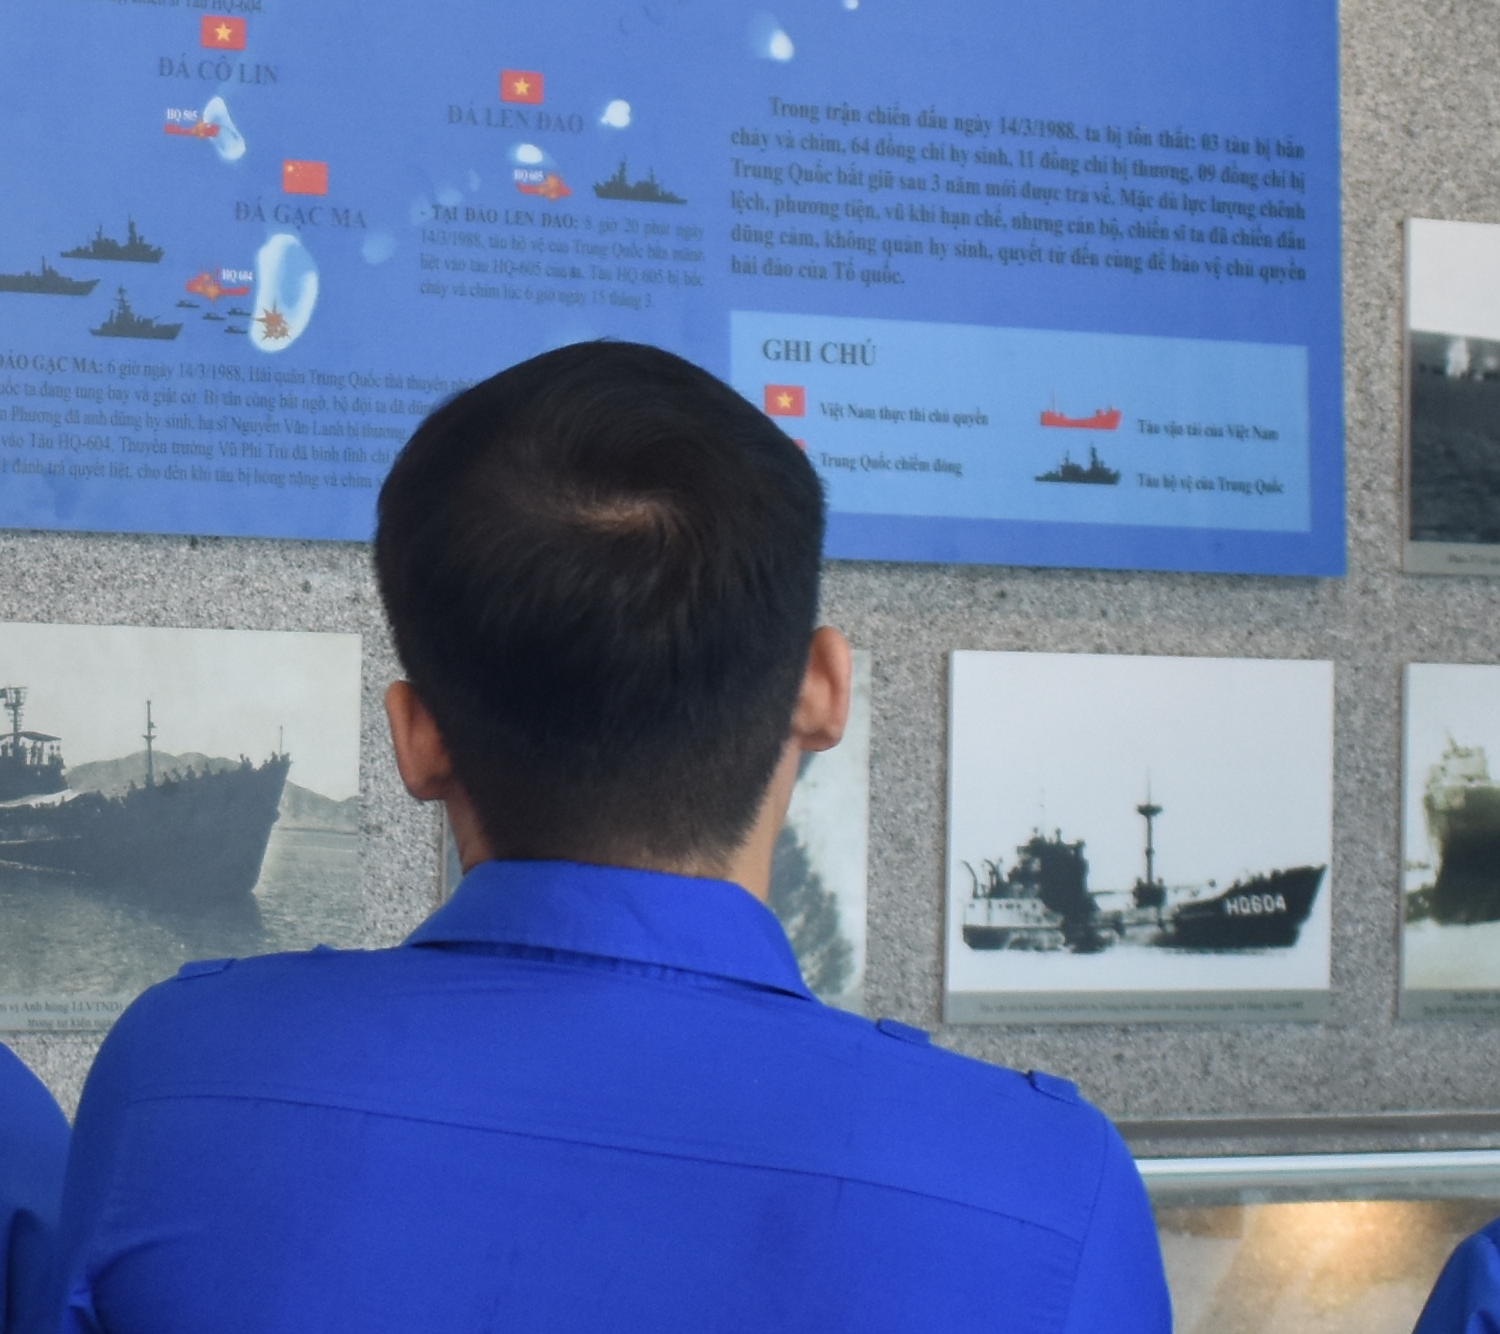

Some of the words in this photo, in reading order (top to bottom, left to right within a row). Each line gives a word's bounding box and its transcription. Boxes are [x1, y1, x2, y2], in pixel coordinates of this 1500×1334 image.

[158, 54, 195, 80] ĐÁ
[199, 55, 232, 82] CÔ
[239, 63, 278, 84] LIN
[166, 108, 184, 122] HQ
[235, 200, 269, 222] ĐÁ
[274, 206, 323, 230] GẠC
[331, 208, 367, 229] MA
[761, 338, 811, 363] GHI
[820, 337, 877, 366] CHÚ
[1225, 894, 1286, 915] HQ604
